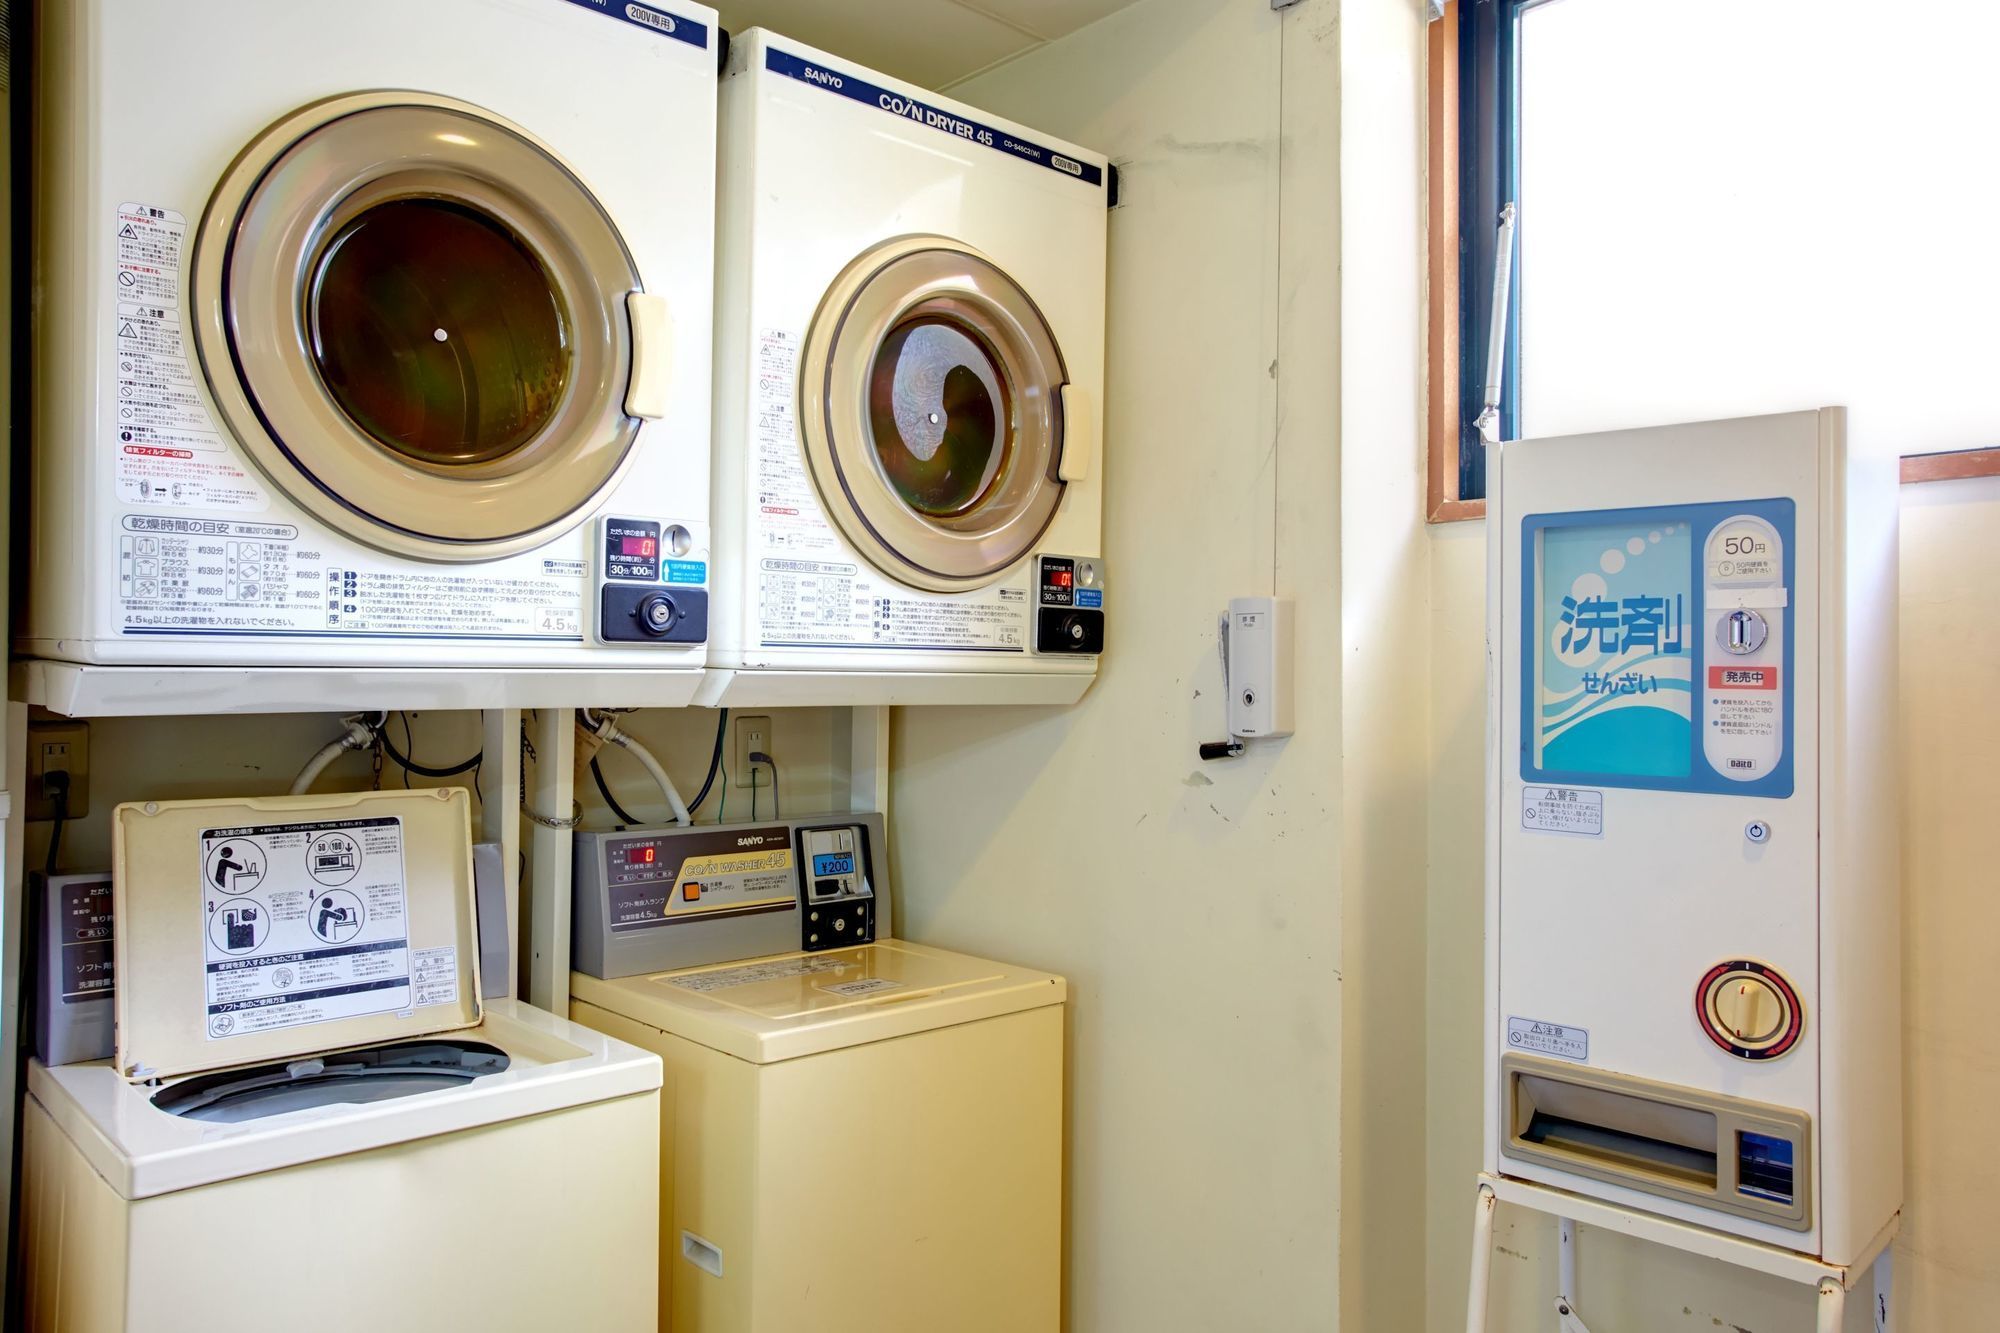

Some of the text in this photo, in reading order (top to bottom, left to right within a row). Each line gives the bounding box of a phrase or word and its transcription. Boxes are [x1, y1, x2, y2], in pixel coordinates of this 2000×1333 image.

[631, 6, 670, 30] 200V専用
[804, 66, 843, 89] SANYO
[879, 93, 993, 146] COIN DRYER 45
[1054, 156, 1079, 174] 200V専用
[149, 208, 165, 219] 警告
[149, 309, 164, 319] 注意
[124, 351, 153, 360] 水をかけない。
[125, 446, 192, 458] 排気フィルターの掃除
[131, 518, 229, 534] 乾燥時間の目安
[197, 546, 224, 555] 約30分
[1725, 536, 1766, 555] 50円
[296, 551, 321, 560] 約60分
[611, 564, 654, 577] 30分/100円
[765, 560, 819, 572] 乾燥時間の目安
[1736, 561, 1769, 569] 50円硬貨を
[197, 567, 224, 576] 約30分
[228, 557, 236, 586] もめん
[296, 571, 320, 580] 約60分
[197, 587, 223, 596] 約60分
[296, 590, 320, 599] 約60分
[328, 572, 340, 625] 操作順序
[361, 606, 496, 617] 100円硬貨を入れてください。乾燥を始めます。
[124, 615, 296, 627] 4.5kg以上の洗濯物を入れないでください。
[1559, 593, 1683, 656] 洗剤
[1582, 671, 1658, 695] せんざい
[1725, 671, 1764, 683] 発売中
[1720, 728, 1773, 736] を左に回して下さい
[1558, 790, 1579, 802] 警告
[1539, 820, 1570, 828] てください。
[213, 828, 254, 837] お洗濯の順序
[306, 832, 312, 844] 2
[205, 840, 211, 852] 1
[318, 843, 326, 852] 50
[331, 842, 342, 851] 100
[737, 836, 764, 847] SANYO
[645, 849, 654, 862] 0
[684, 852, 786, 877] COIN WASHER 45
[821, 859, 849, 874] ¥200
[309, 888, 315, 901] 4
[208, 901, 214, 913] 3
[87, 927, 105, 937] 洗い
[218, 953, 305, 971] 硬貨を投入するときのご注意
[78, 978, 114, 990] 洗濯容量
[219, 996, 286, 1012] ソフト剤のご使用方法
[1543, 1025, 1564, 1038] 注意
